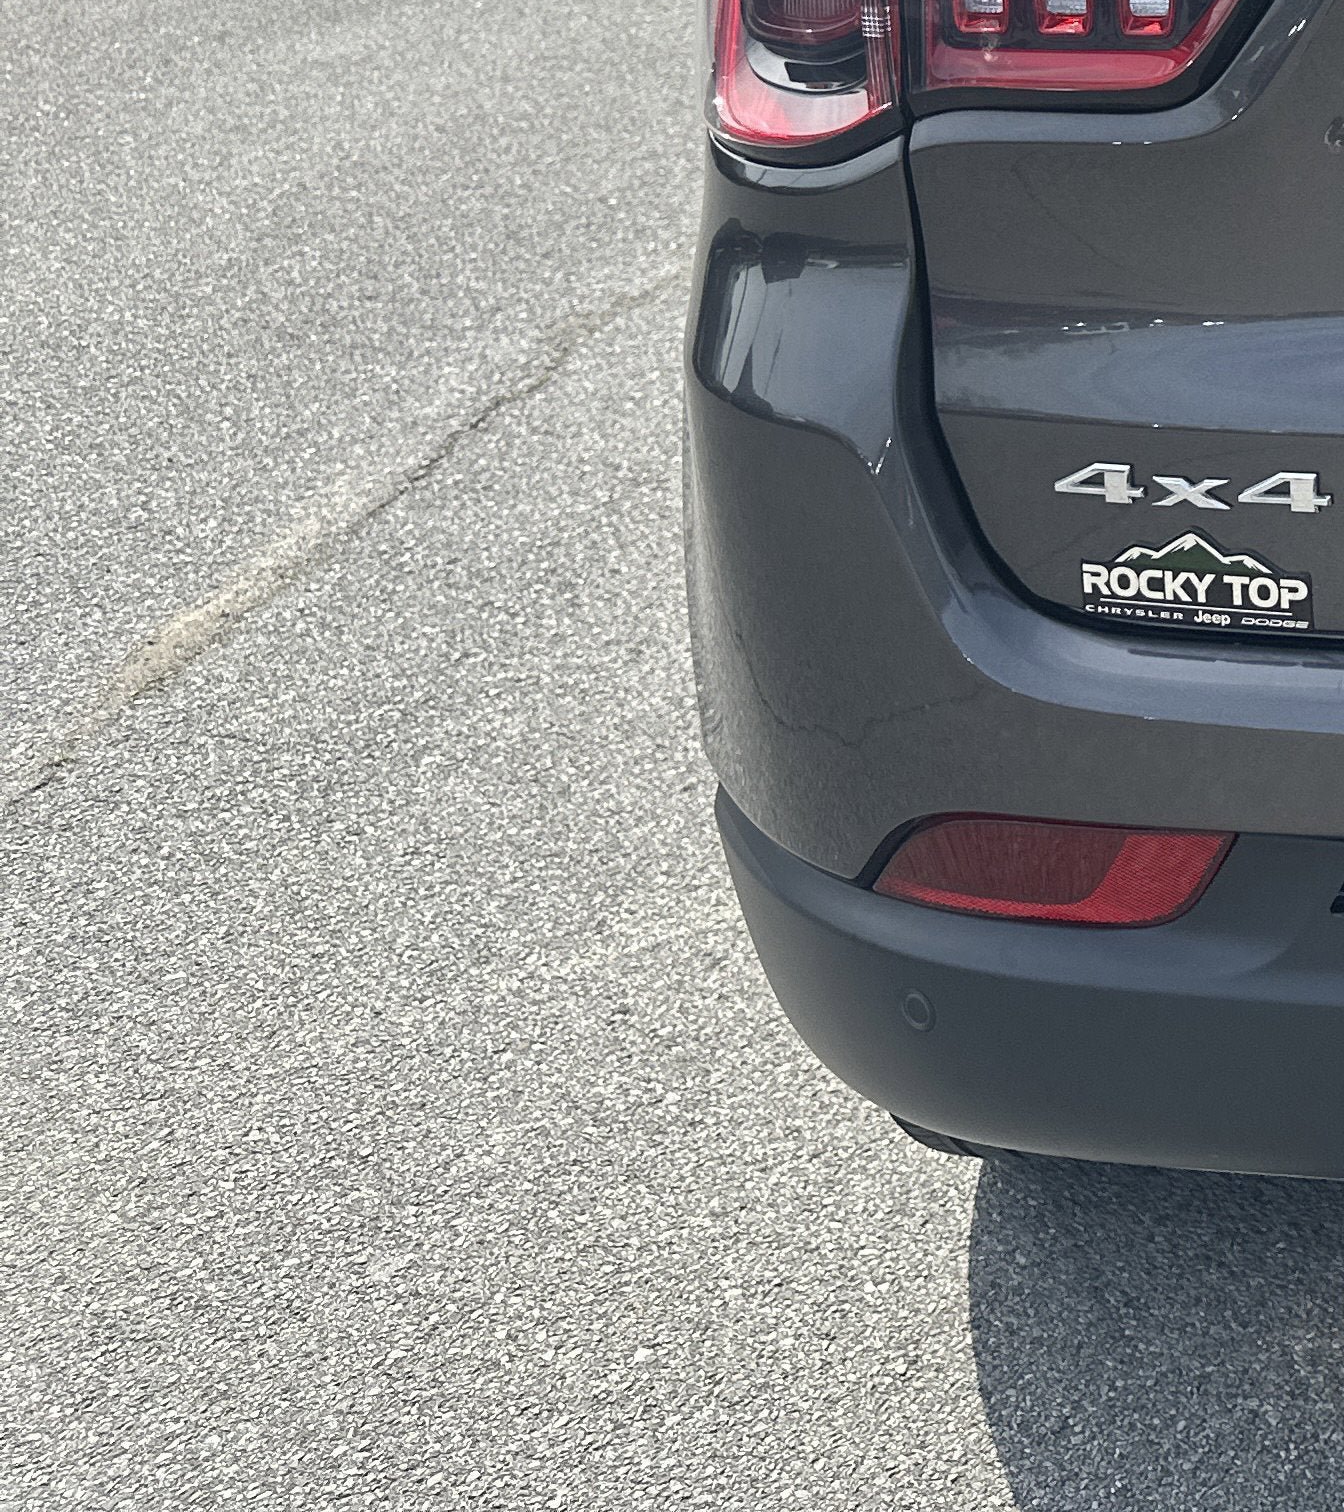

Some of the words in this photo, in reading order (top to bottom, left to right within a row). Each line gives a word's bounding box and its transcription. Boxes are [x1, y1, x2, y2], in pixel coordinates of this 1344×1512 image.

[1054, 461, 1332, 513] 4x4
[1082, 563, 1217, 604] ROCKY
[1223, 575, 1309, 610] TOP
[1084, 604, 1184, 621] CHRYSLER
[1193, 609, 1231, 627] Jeep
[1240, 617, 1310, 630] DODGE
